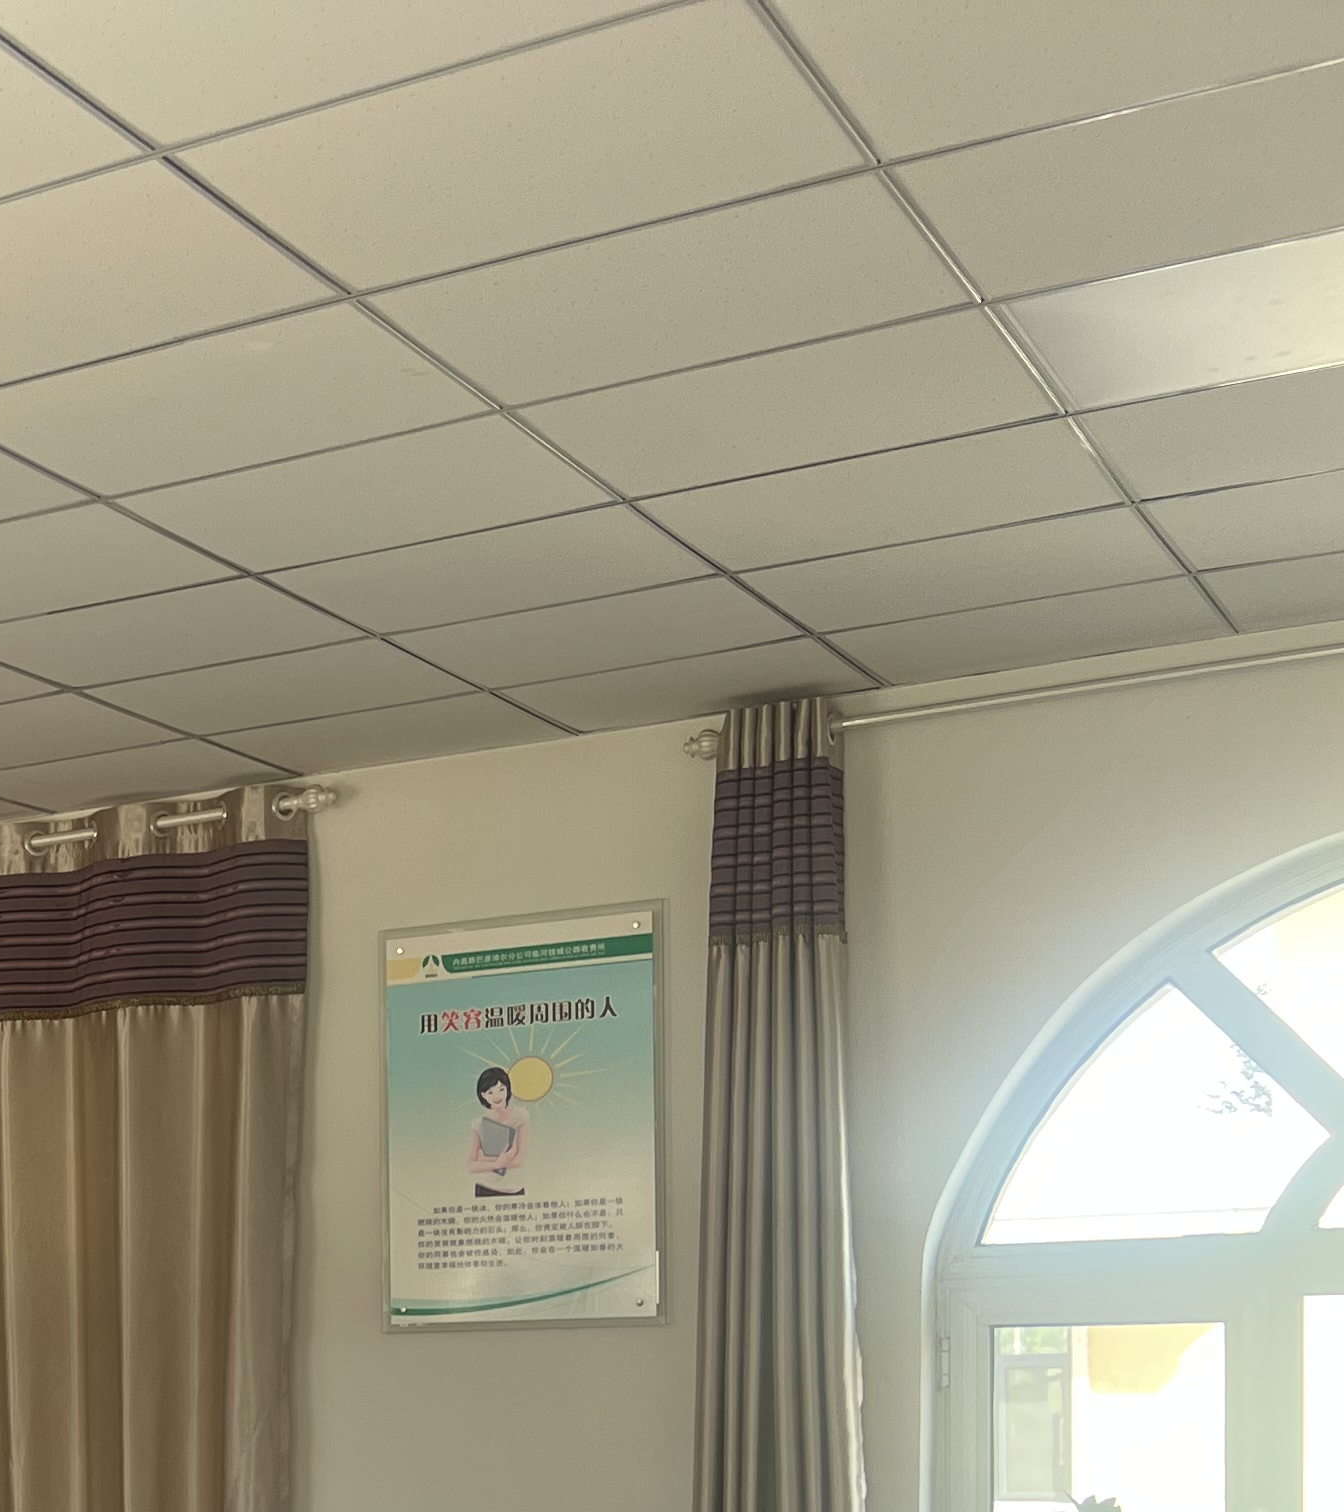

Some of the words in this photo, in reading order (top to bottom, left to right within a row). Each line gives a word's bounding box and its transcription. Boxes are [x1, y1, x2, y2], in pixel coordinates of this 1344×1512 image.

[419, 995, 618, 1036] 用笑容温暖周围的人
